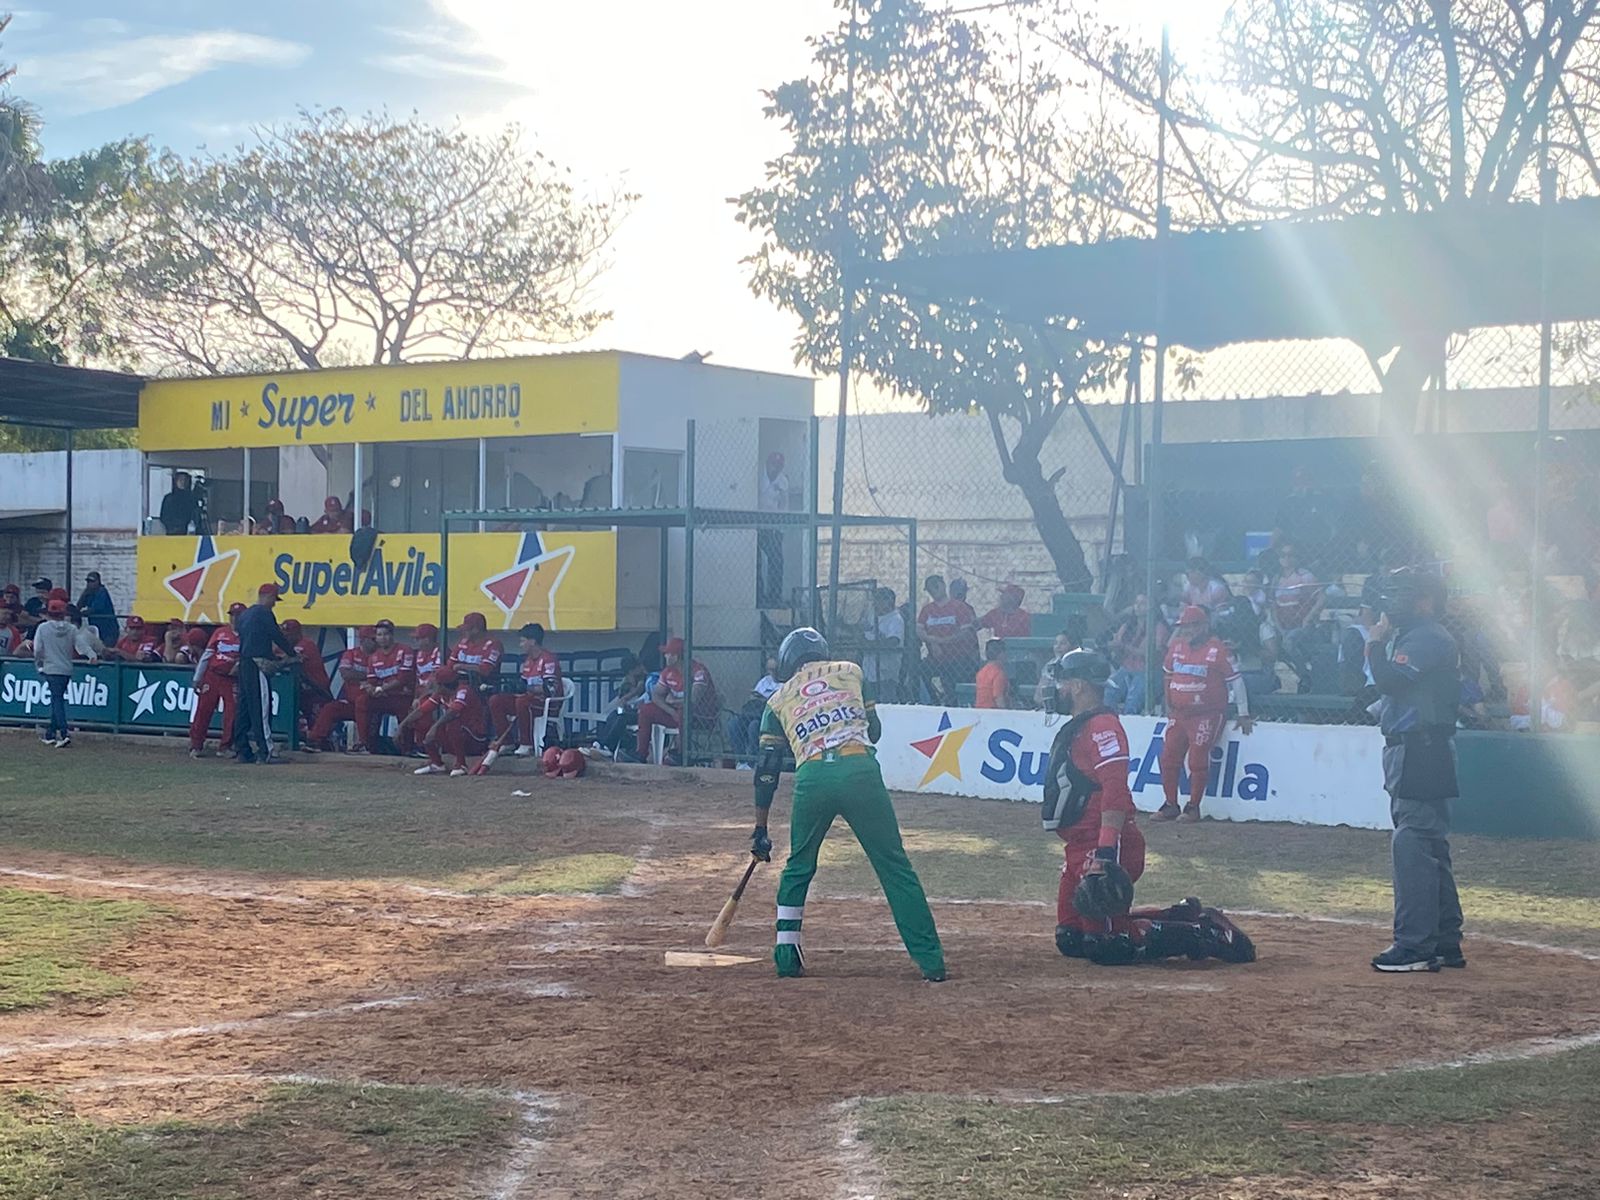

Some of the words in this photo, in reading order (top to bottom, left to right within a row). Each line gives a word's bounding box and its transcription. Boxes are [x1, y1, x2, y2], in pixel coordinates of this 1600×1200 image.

[211, 400, 231, 432] MI
[257, 382, 355, 440] Super
[399, 388, 433, 423] DEL
[442, 383, 521, 421] AHORRO
[273, 539, 441, 609] SuperÁvila
